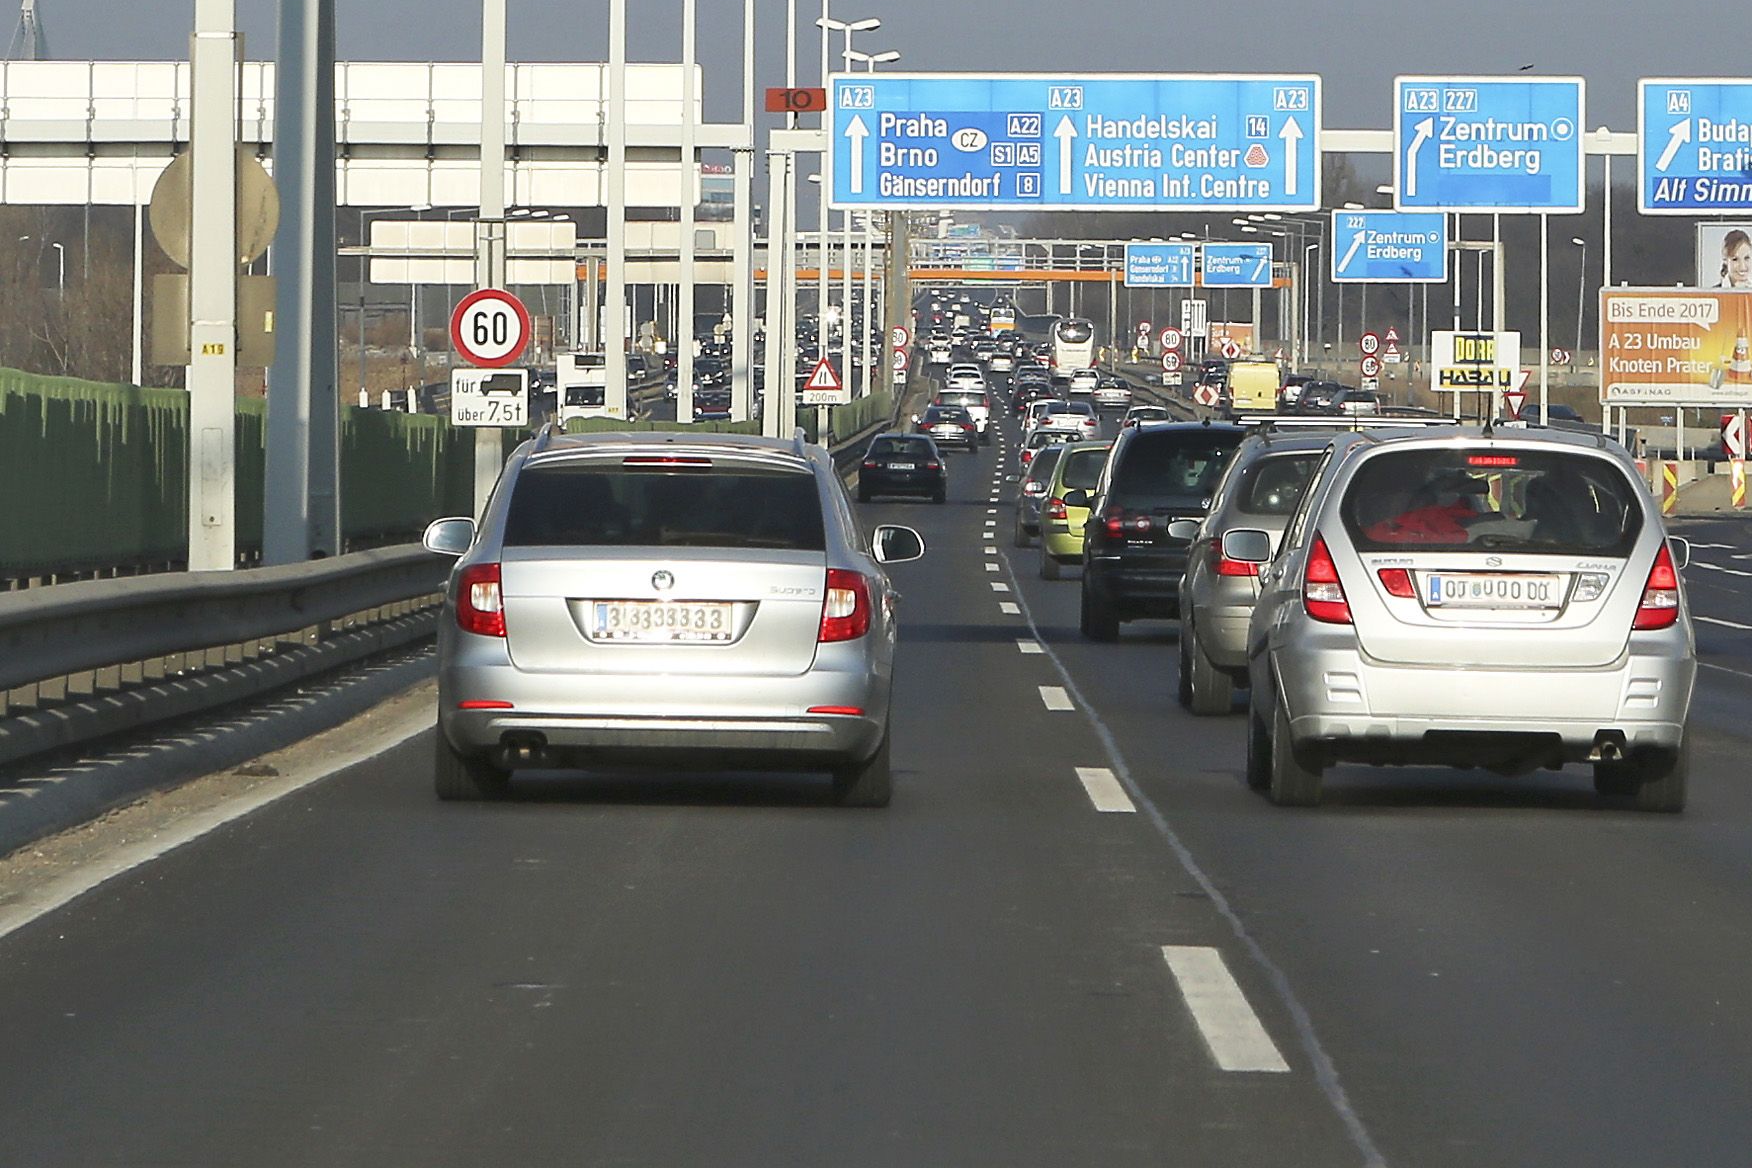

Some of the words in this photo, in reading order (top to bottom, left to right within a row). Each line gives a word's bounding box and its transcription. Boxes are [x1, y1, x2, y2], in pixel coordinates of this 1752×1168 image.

[780, 90, 812, 109] 10
[842, 87, 873, 107] A23
[1051, 87, 1081, 108] A23
[1276, 88, 1307, 109] A23
[1406, 91, 1438, 111] A23
[1446, 91, 1476, 111] 227
[1669, 92, 1689, 113] A4
[880, 113, 948, 138] Praha
[1009, 116, 1039, 136] A22
[1086, 115, 1217, 139] Handelskai
[1248, 118, 1267, 136] 14
[1439, 116, 1550, 142] Zentrum
[960, 132, 979, 148] CZ
[880, 143, 939, 168] Brno
[995, 146, 1013, 165] S1
[1018, 146, 1039, 165] A5
[1085, 144, 1165, 169] Austria
[1172, 145, 1240, 169] Center
[1439, 145, 1541, 174] Erdberg
[880, 172, 1001, 199] Gänserndorf
[1023, 176, 1033, 194] 8
[1084, 174, 1155, 199] Vienna
[1163, 174, 1197, 199] Int.
[1200, 175, 1270, 200] Centre
[1367, 231, 1427, 245] Zentrum
[1367, 245, 1423, 262] Erdberg
[1206, 264, 1240, 275] Erdberg
[1612, 302, 1633, 318] Bis
[1639, 302, 1675, 318] Ende
[1680, 303, 1713, 319] 2017
[473, 311, 508, 346] 60
[1608, 333, 1620, 349] A
[1624, 333, 1642, 350] 23
[1647, 333, 1701, 349] Umbau
[1609, 357, 1663, 373] Knoten
[1666, 357, 1712, 374] Prater
[455, 378, 476, 394] für
[1440, 370, 1511, 386] HABAU
[457, 406, 485, 422] über
[487, 401, 522, 423] 7,5t
